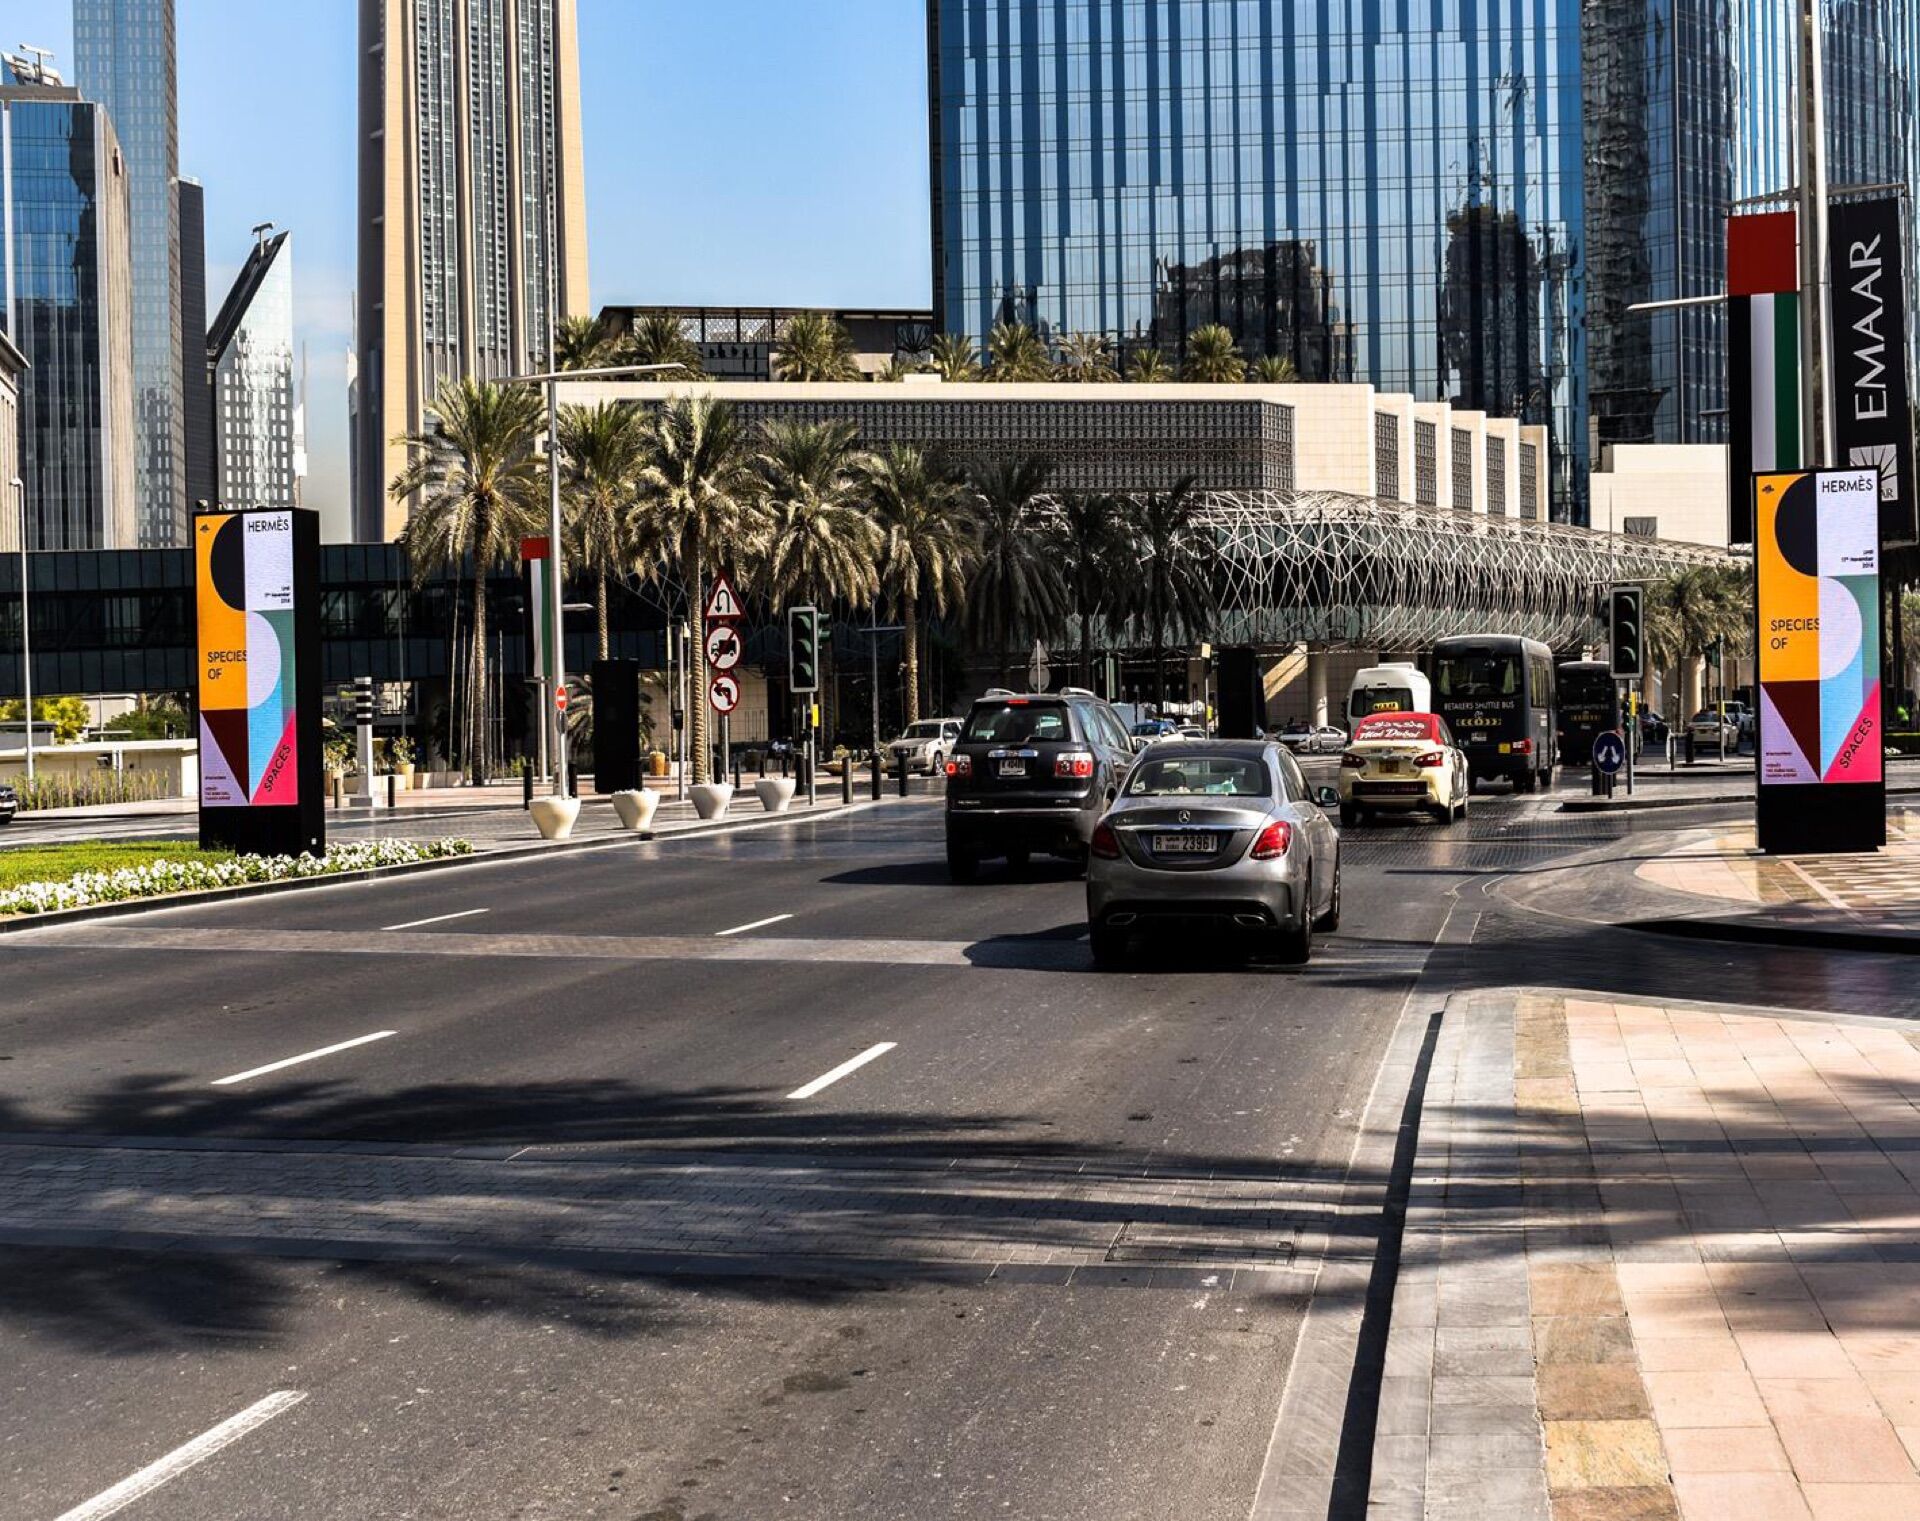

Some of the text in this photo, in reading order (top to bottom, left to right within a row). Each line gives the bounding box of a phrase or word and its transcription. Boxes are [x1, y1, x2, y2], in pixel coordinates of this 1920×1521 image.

[1850, 233, 1887, 421] EMAAR
[1822, 476, 1874, 493] HERMÈS
[248, 516, 290, 532] HERMÈS
[1770, 618, 1820, 632] SPECIES
[1770, 637, 1788, 650] OF
[207, 650, 248, 663] SPECIES
[207, 668, 222, 680] OF
[1475, 701, 1500, 709] SHUTTLE
[1502, 701, 1515, 709] BUS
[1839, 717, 1874, 769] SPACES
[264, 744, 292, 792] SPACES
[1183, 836, 1215, 850] 23961
